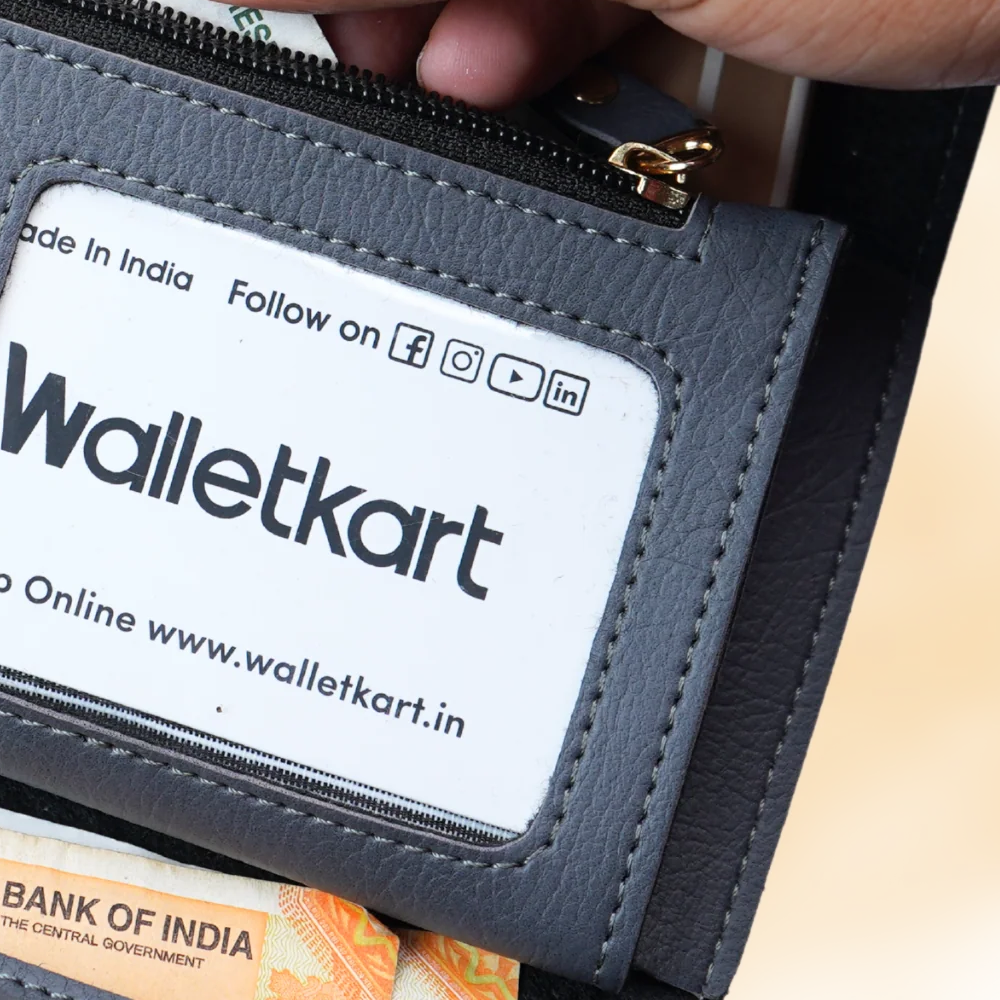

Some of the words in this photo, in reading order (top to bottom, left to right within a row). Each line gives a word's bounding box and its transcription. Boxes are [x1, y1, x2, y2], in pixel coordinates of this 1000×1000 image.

[84, 237, 111, 266] In
[119, 248, 194, 292] India
[228, 279, 331, 332] Follow
[339, 320, 381, 349] on
[0, 340, 504, 601] Walletkart
[25, 575, 136, 632] Online
[148, 619, 465, 738] www.walletkart.in
[1, 915, 29, 932] THE
[32, 922, 99, 947] CENTRAL
[102, 937, 205, 970] GOVERNMENT
[2, 880, 101, 926] BANK
[107, 902, 156, 936] OF
[161, 914, 254, 960] INDIA
